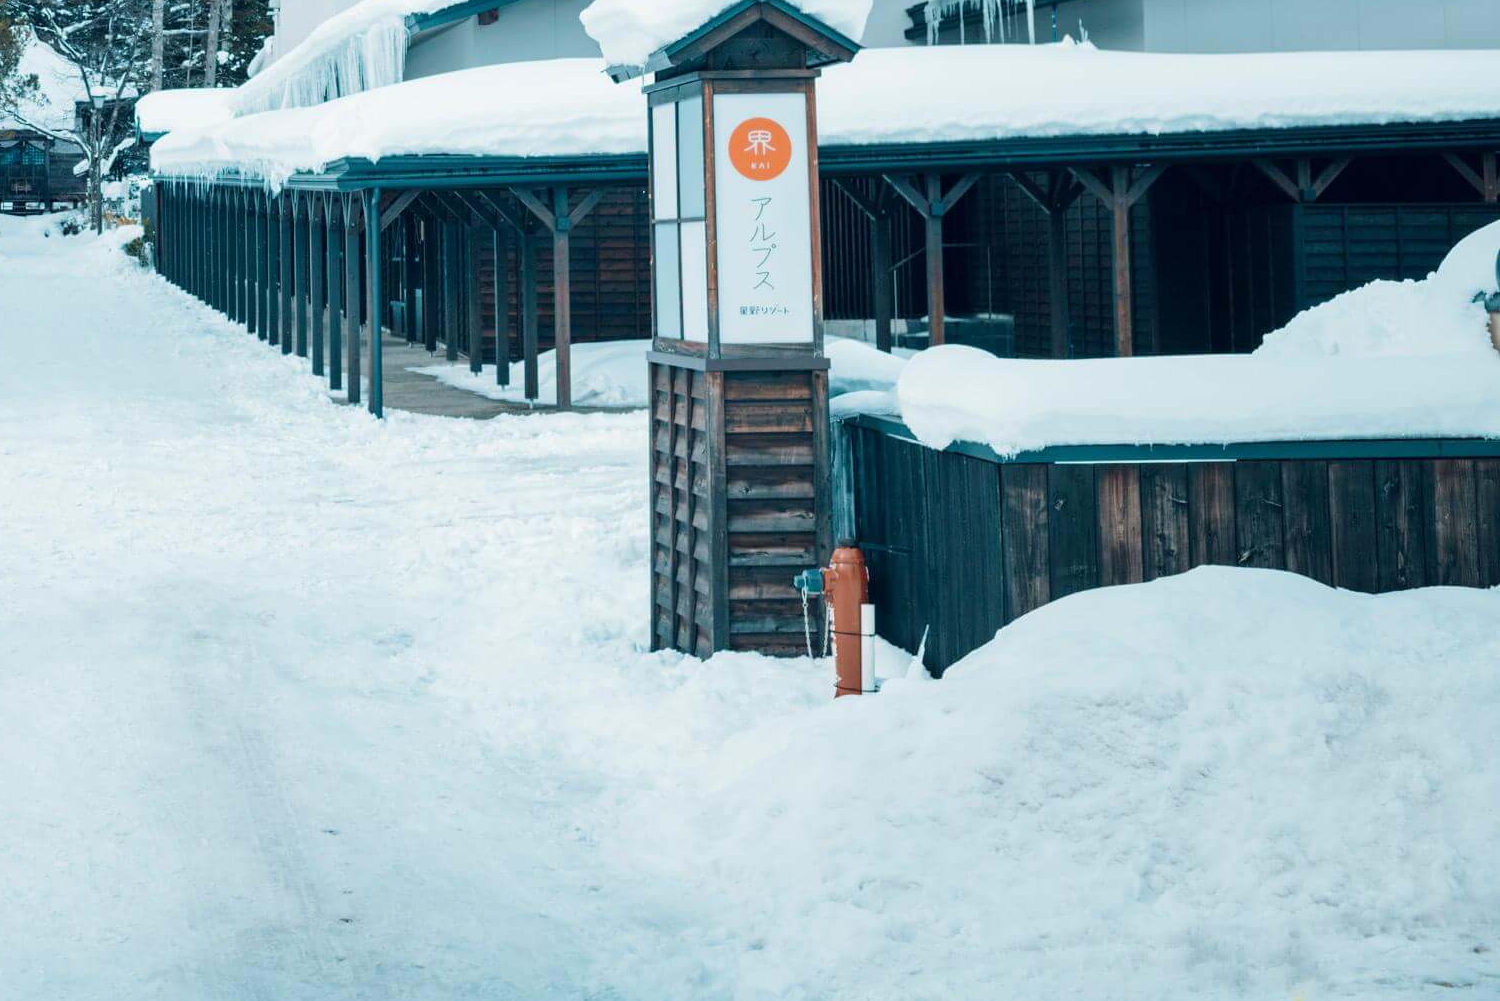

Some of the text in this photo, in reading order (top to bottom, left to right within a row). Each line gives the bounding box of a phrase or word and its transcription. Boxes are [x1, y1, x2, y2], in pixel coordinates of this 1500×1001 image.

[743, 130, 777, 156] 界
[750, 162, 771, 170] KAI
[749, 197, 777, 291] アルプス
[739, 305, 790, 316] 星野リゾート
